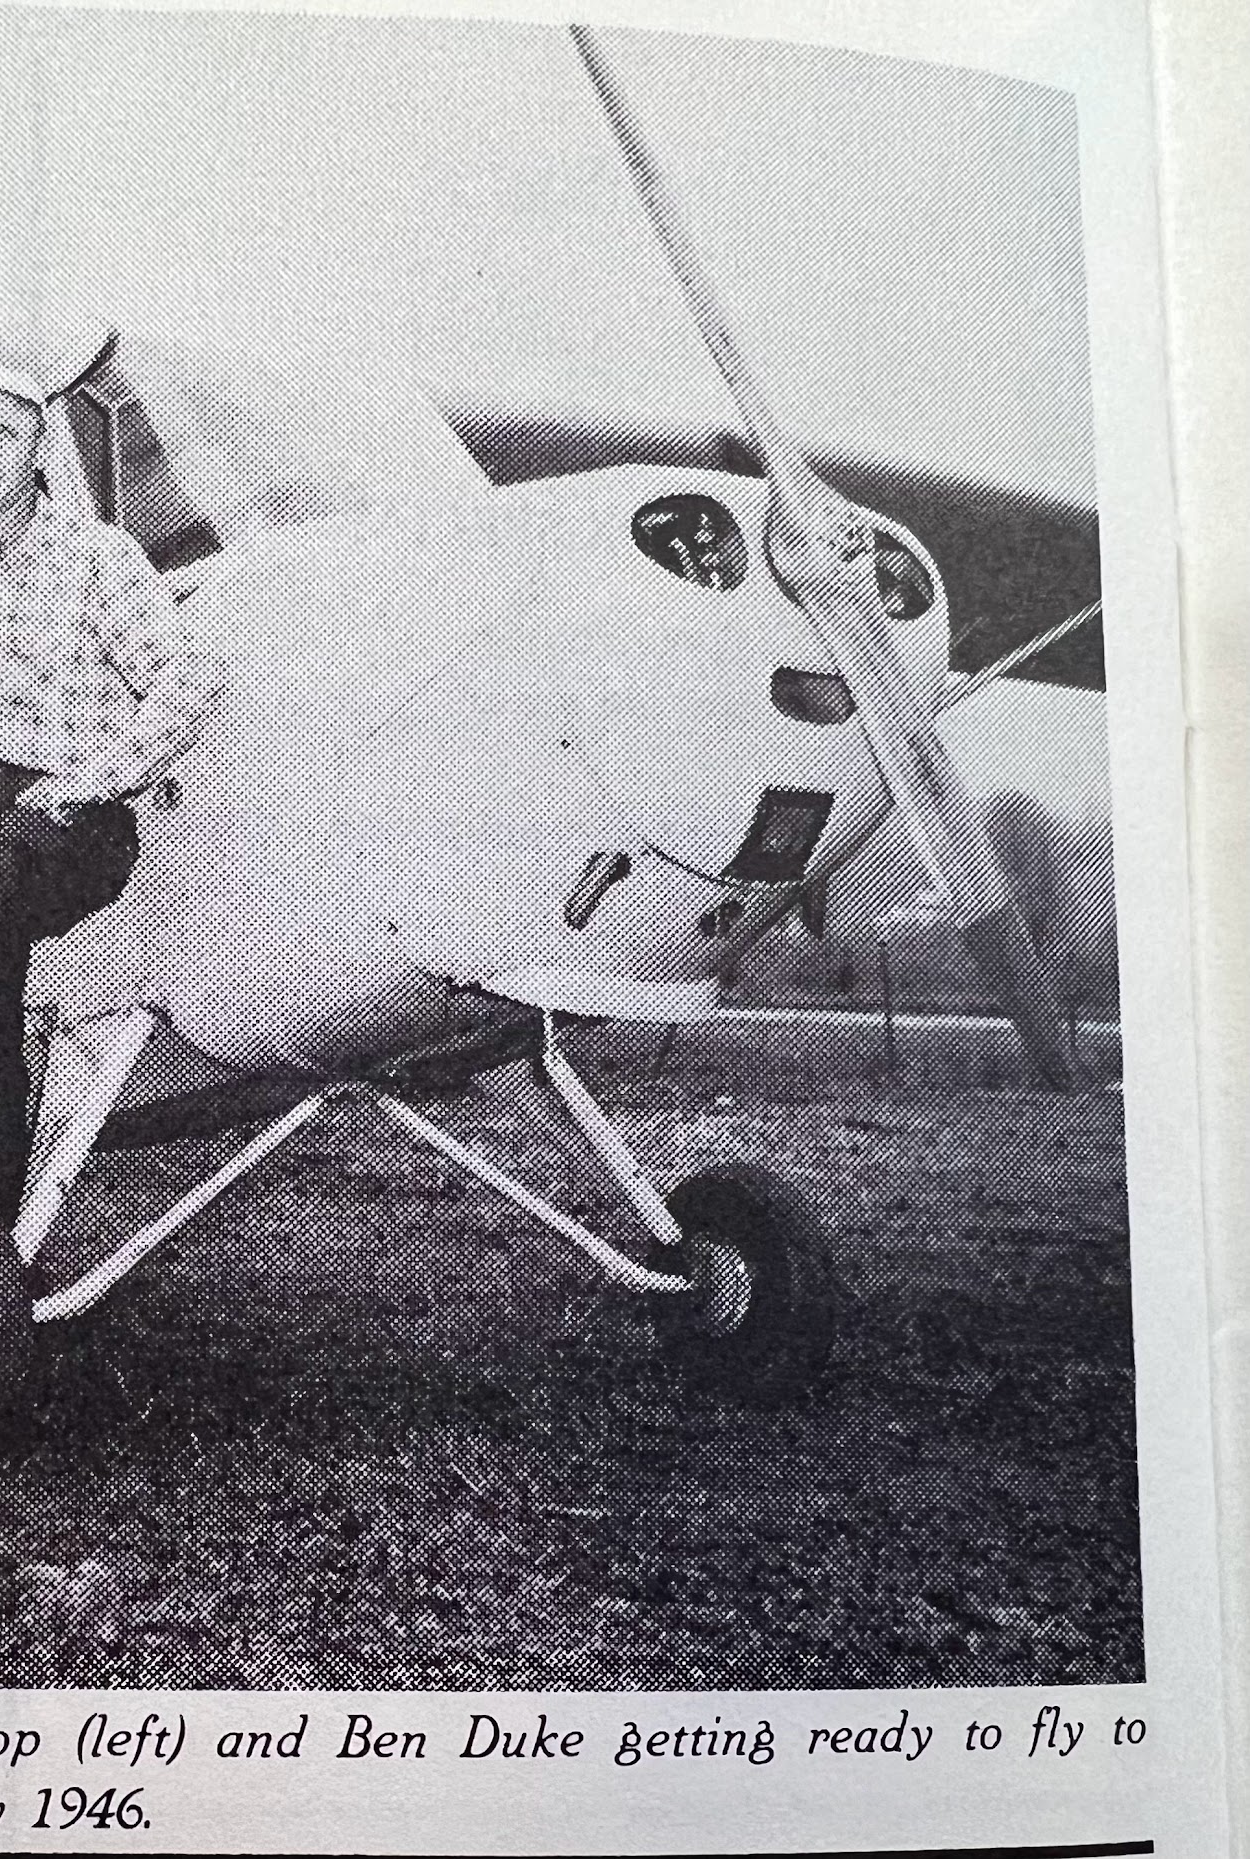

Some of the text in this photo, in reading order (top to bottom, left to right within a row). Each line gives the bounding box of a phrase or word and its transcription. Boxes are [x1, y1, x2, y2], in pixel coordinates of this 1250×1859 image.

[78, 1713, 186, 1767] (left)
[217, 1715, 309, 1759] and
[336, 1715, 427, 1759] Ben
[460, 1715, 584, 1758] Duke
[615, 1717, 775, 1767] getting
[809, 1710, 933, 1761] ready
[966, 1717, 1002, 1751] to
[1029, 1706, 1084, 1757] fly
[1114, 1717, 1146, 1745] to
[32, 1787, 152, 1829] 1946.
